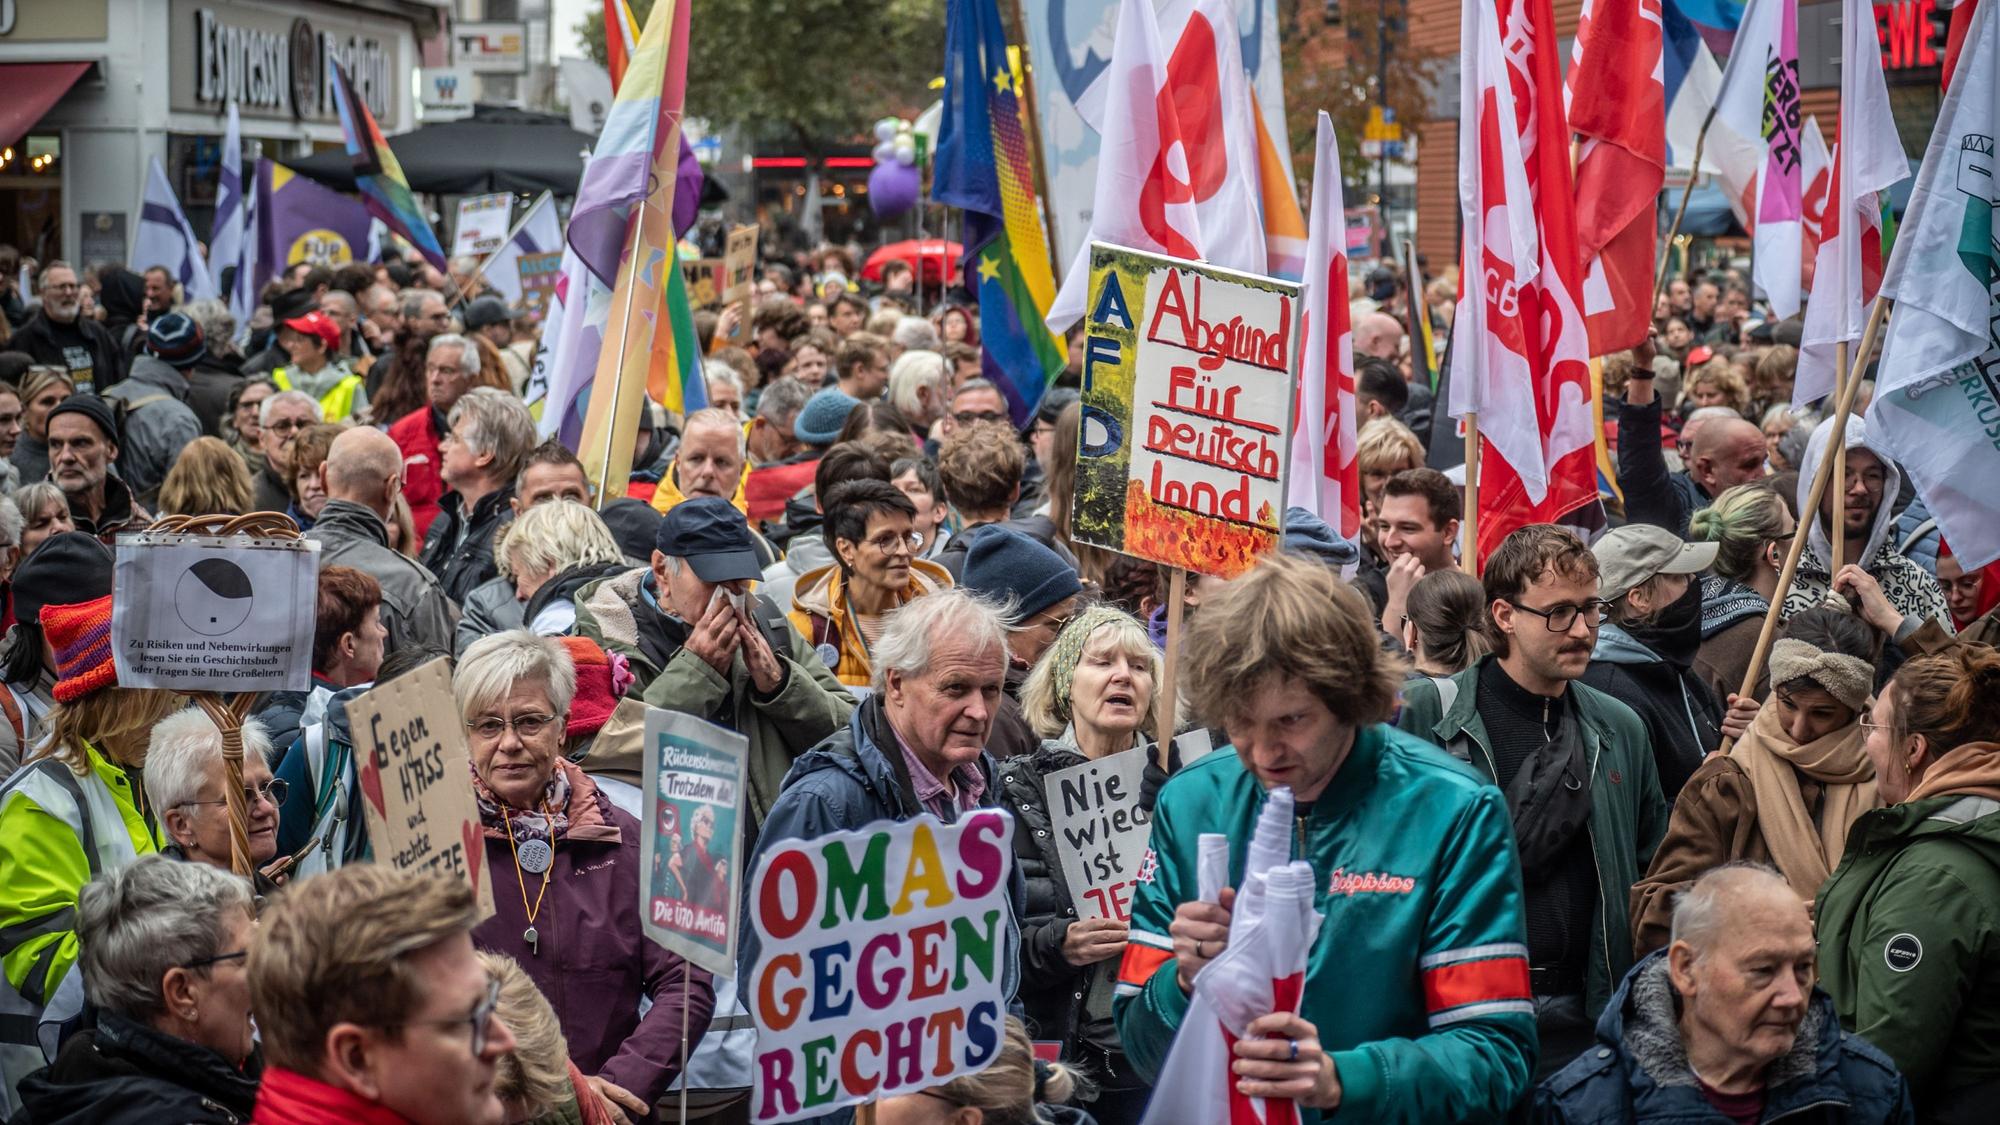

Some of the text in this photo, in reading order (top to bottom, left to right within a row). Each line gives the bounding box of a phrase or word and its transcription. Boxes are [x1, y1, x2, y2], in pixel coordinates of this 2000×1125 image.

[198, 8, 289, 107] Espresso
[458, 34, 520, 54] TLS
[1872, 0, 1937, 69] EWE
[1761, 90, 1802, 176] ETZT
[1485, 267, 1519, 318] GB
[1147, 267, 1291, 371] Abgrund
[1167, 365, 1242, 418] Für
[1148, 414, 1280, 480] Deutsch
[129, 639, 292, 654] Zu Risiken und Nebenwirkungen
[131, 664, 284, 678] oder fragen Sie Ihre Großeltern
[140, 652, 278, 666] lesen Sie ein Geschichtsbuch
[370, 712, 430, 769] Gegen
[399, 742, 445, 804] HASS
[666, 772, 715, 801] Trotzdem
[1060, 768, 1127, 818] Nie
[406, 799, 428, 830] und
[391, 832, 433, 871] rechte
[521, 844, 533, 863] OMAS
[526, 845, 540, 868] GEGEN
[759, 812, 1005, 940] OMAS
[1079, 840, 1124, 887] ist
[654, 900, 727, 937] Die Ü70 Antifa
[757, 909, 1001, 1032] GEGEN
[758, 1000, 998, 1120] RECHTS
